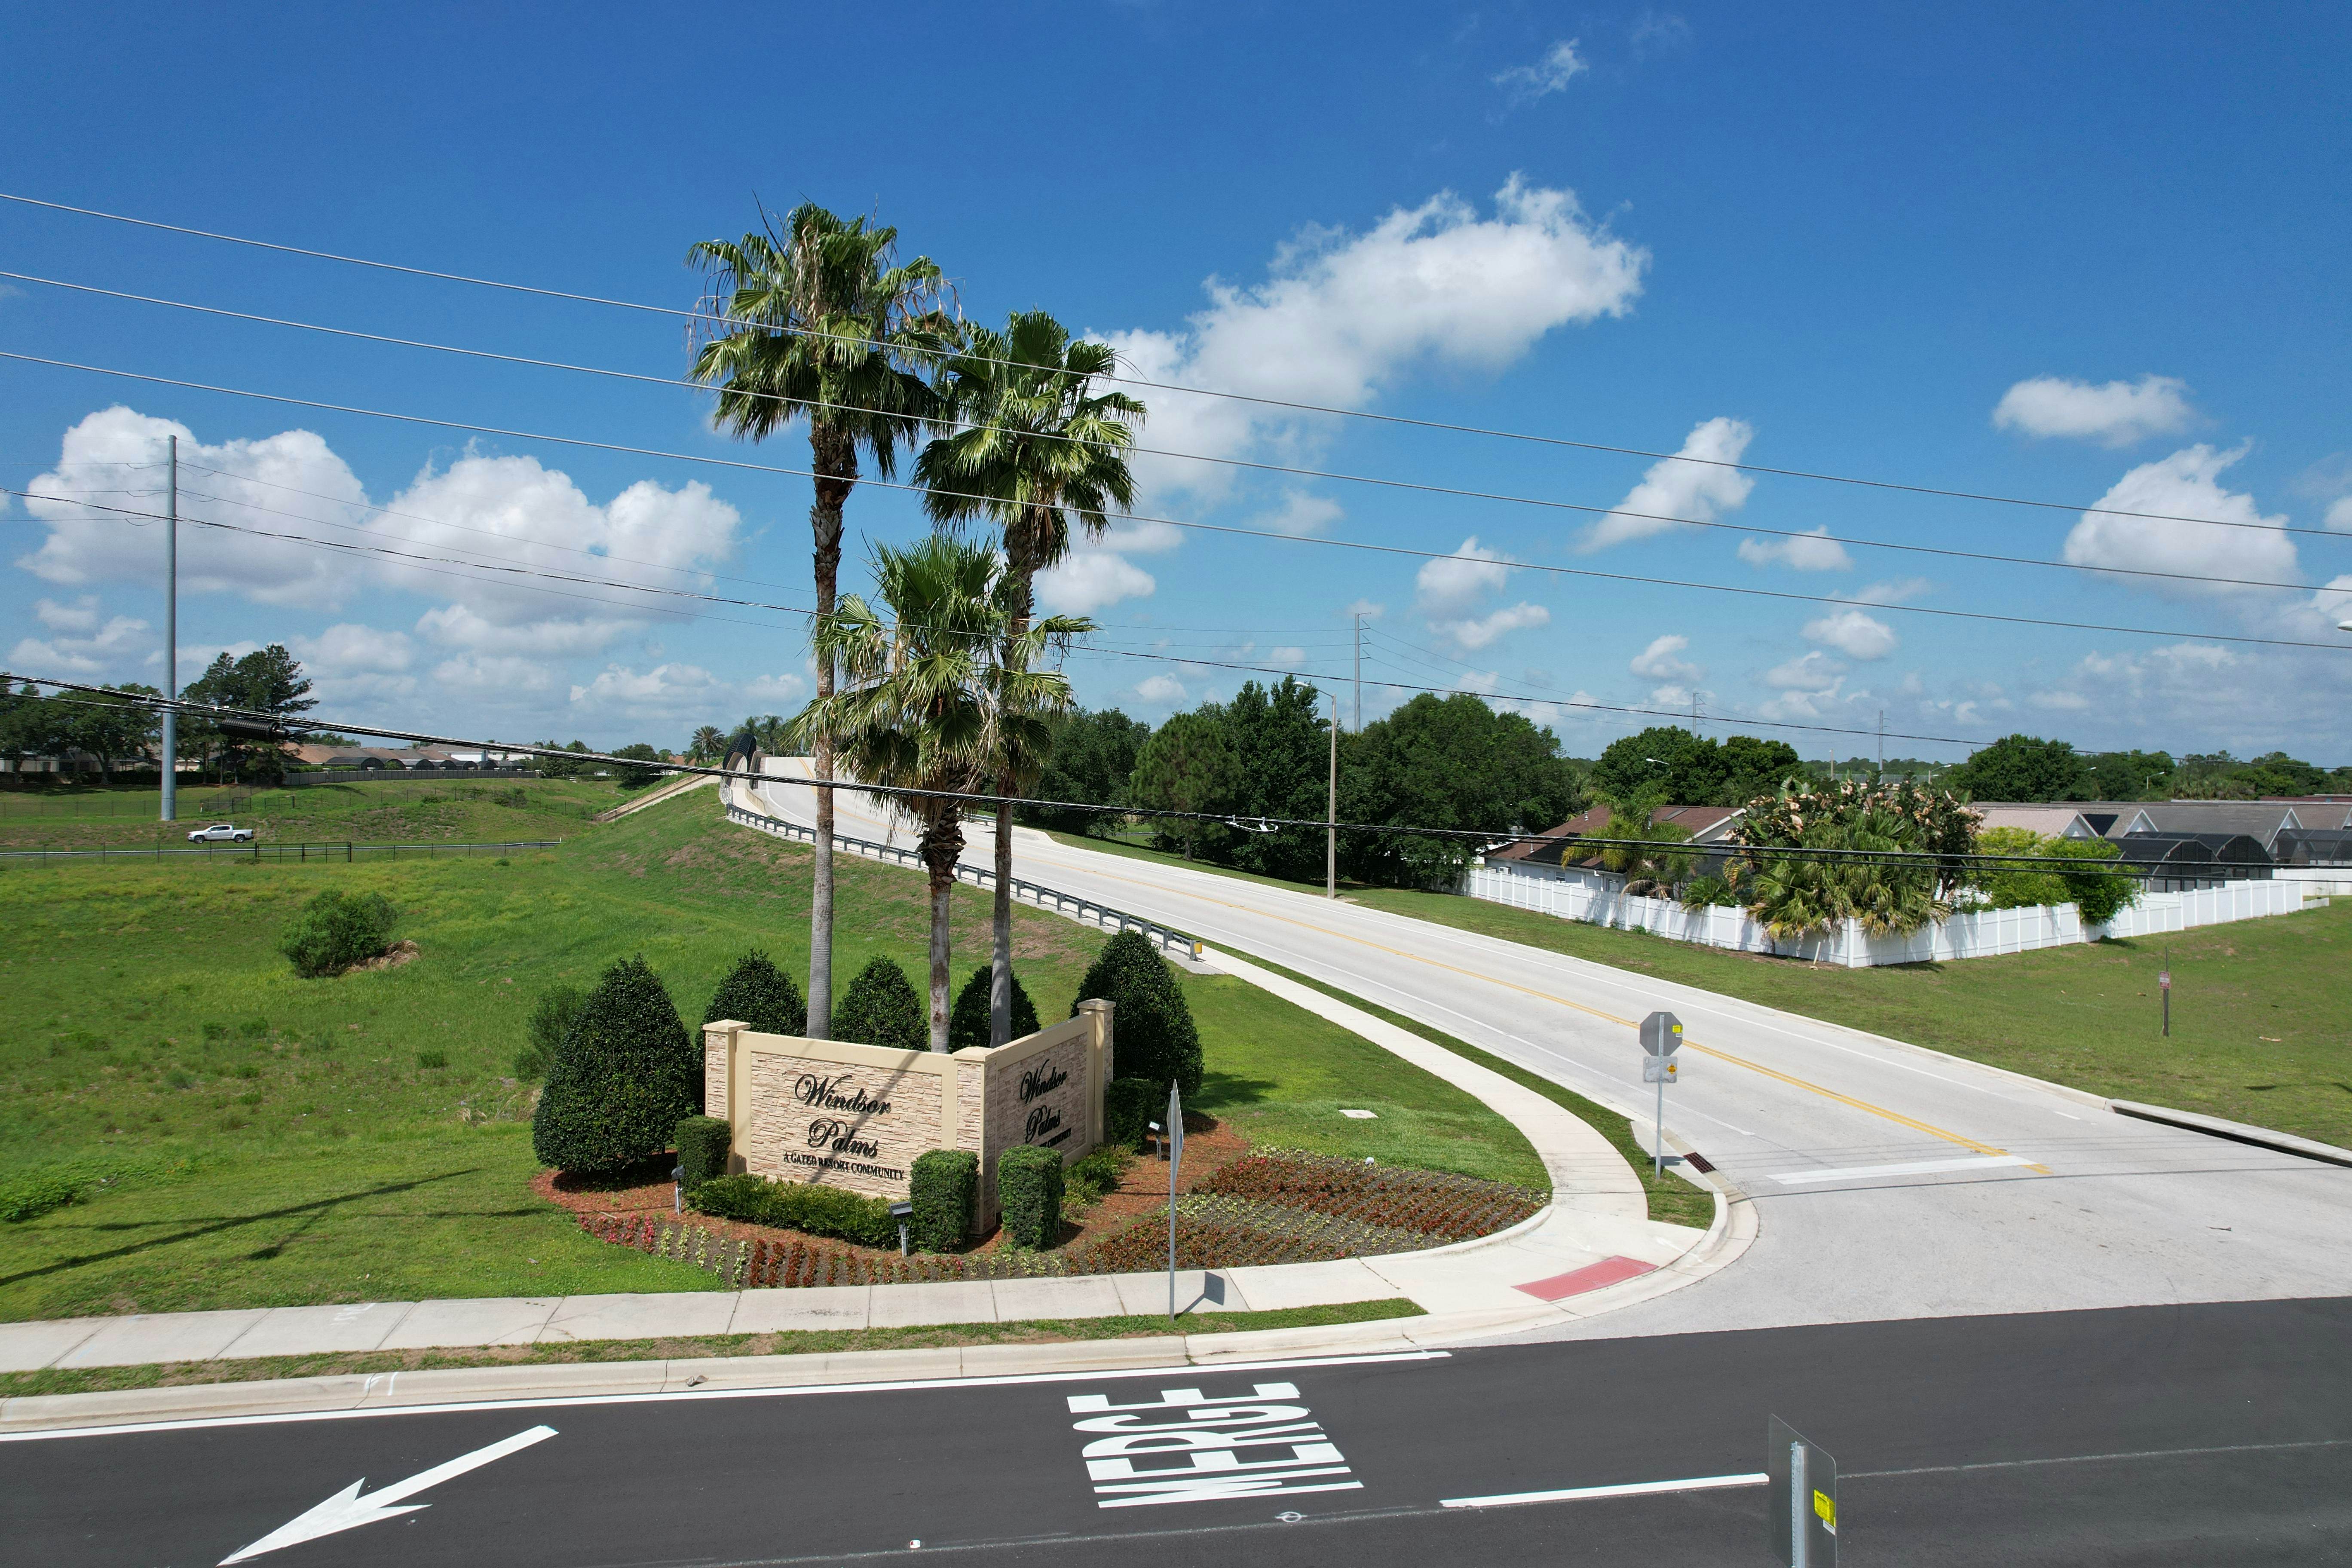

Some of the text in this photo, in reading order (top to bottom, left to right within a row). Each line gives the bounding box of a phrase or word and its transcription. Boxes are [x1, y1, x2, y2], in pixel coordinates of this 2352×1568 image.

[795, 1074, 891, 1115] Windsor
[1020, 1059, 1067, 1104] Windsor
[807, 1118, 878, 1158] Palms
[1025, 1105, 1060, 1143] Palms
[784, 1152, 904, 1181] A GATED RESORT COMMUNITY
[1067, 1382, 1364, 1508] MERGE
